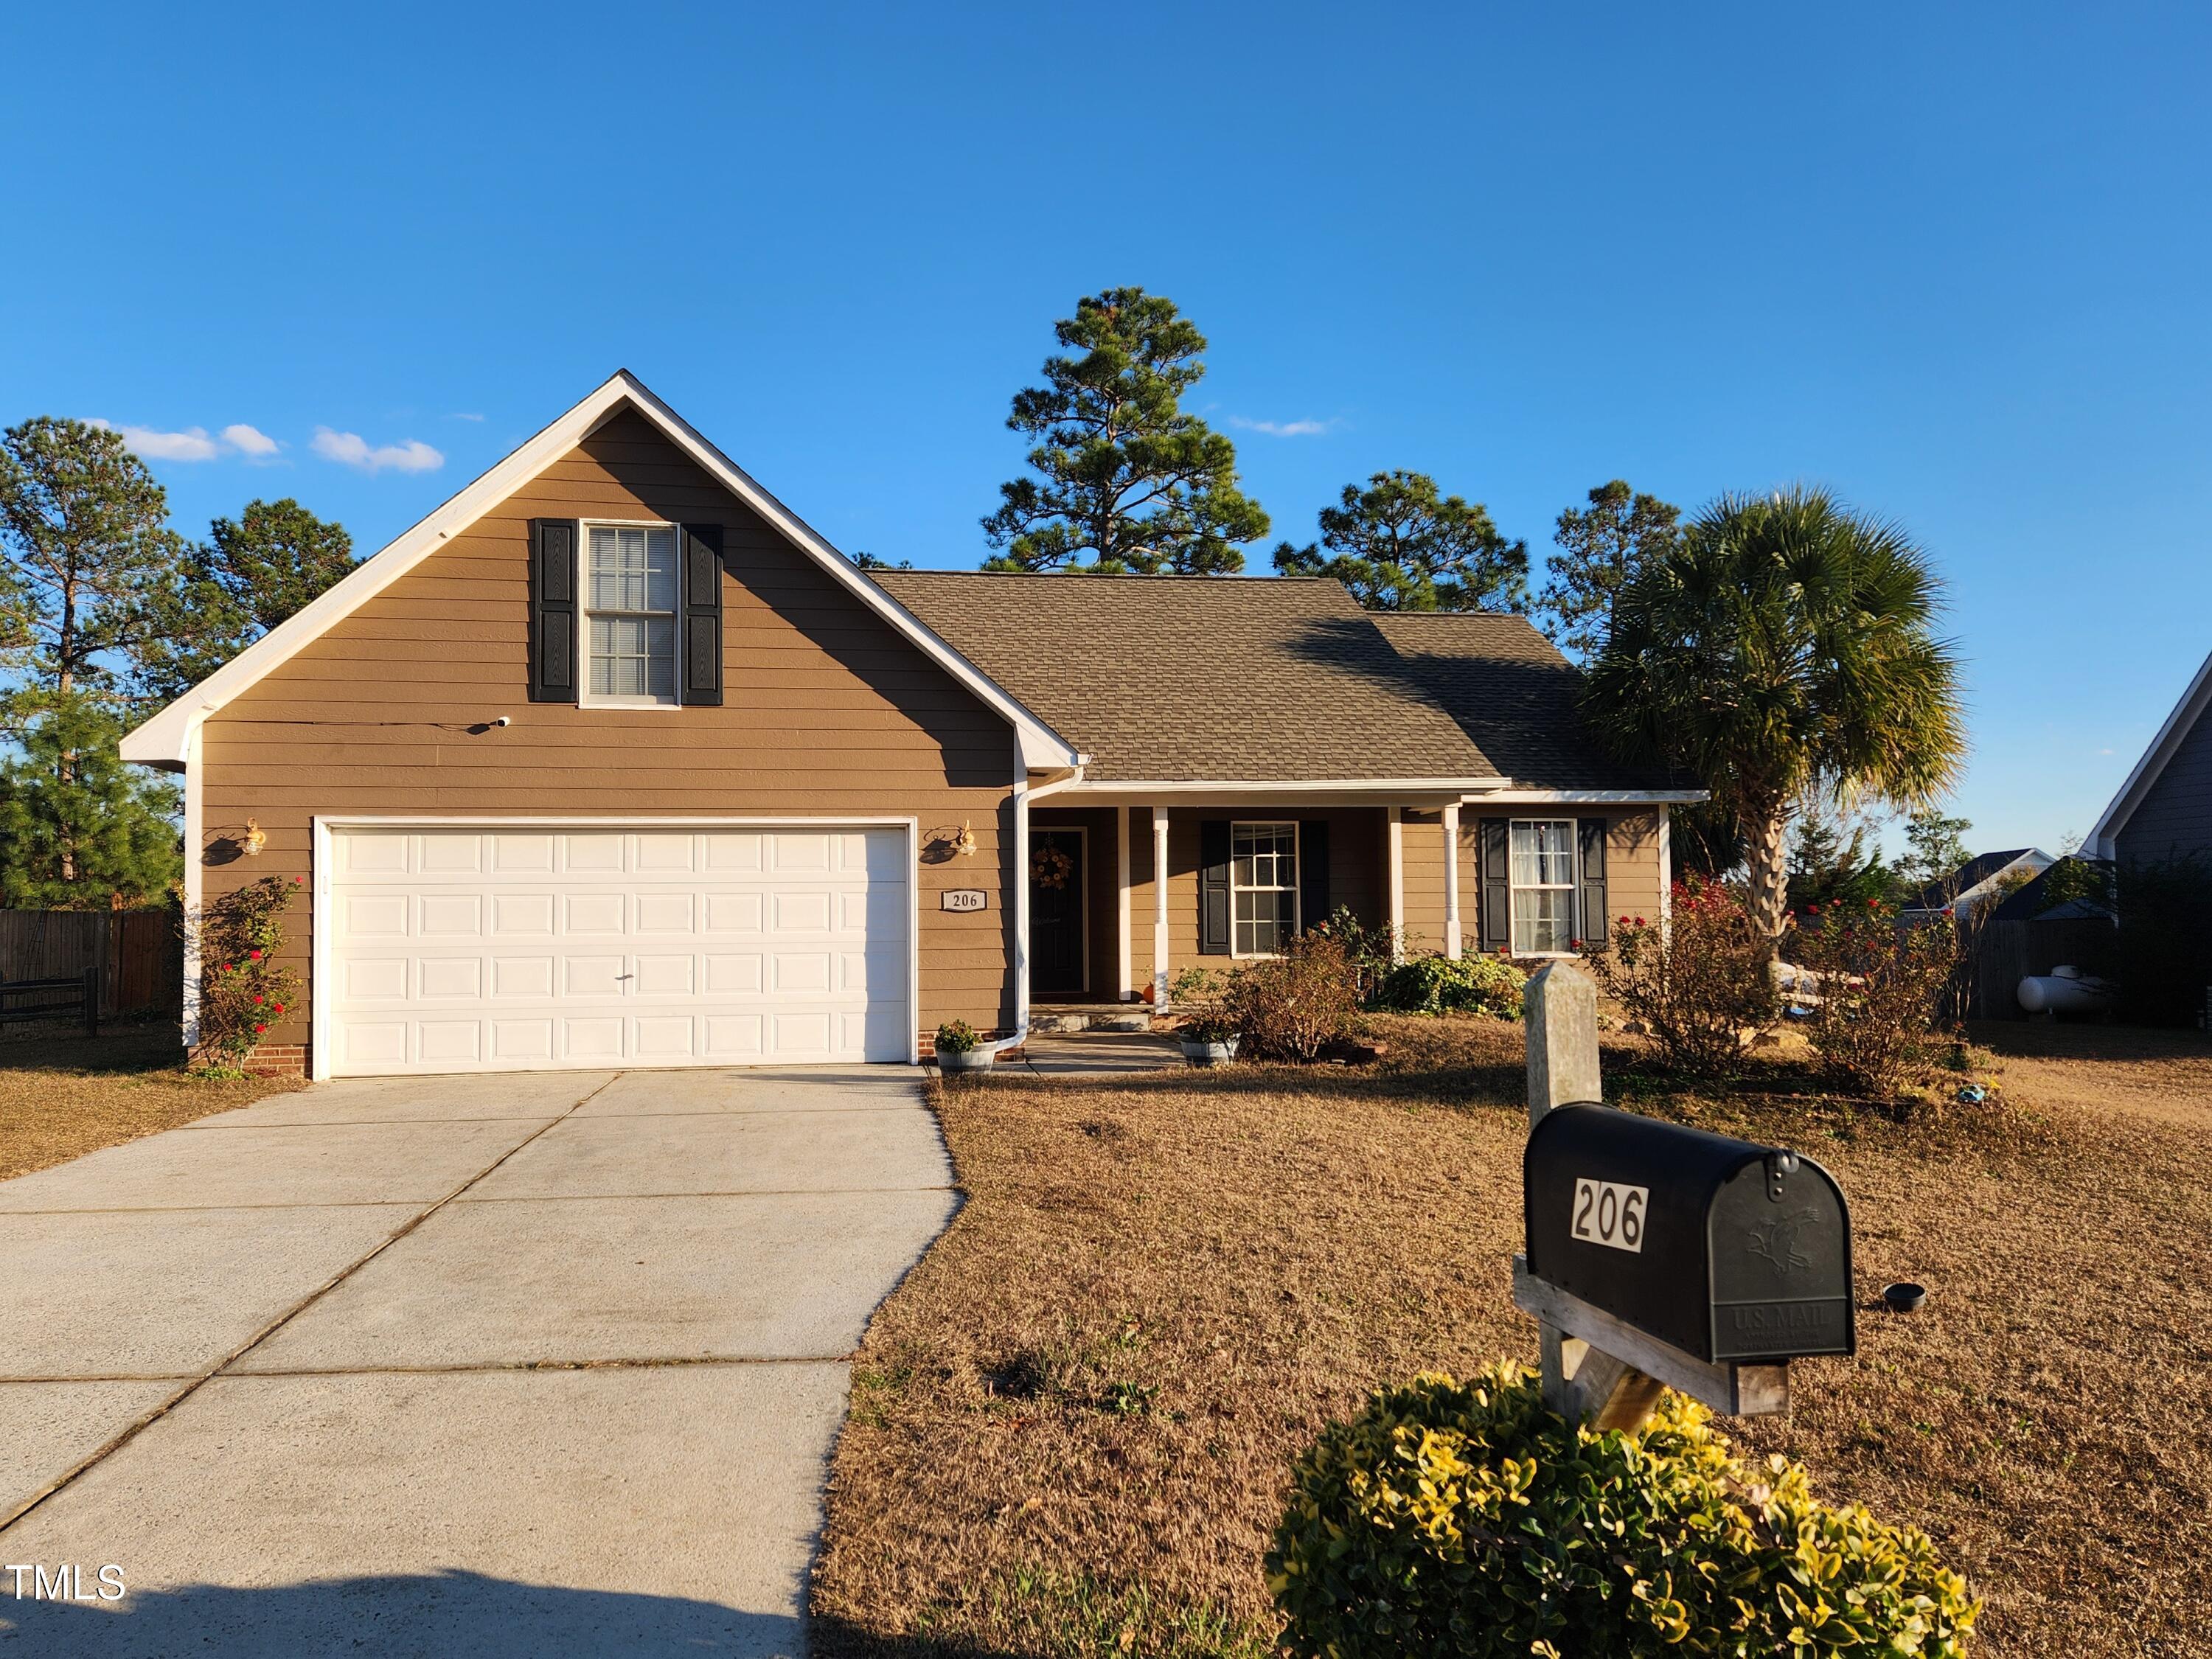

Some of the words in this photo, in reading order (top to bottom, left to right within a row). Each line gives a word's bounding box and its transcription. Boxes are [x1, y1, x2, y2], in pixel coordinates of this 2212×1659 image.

[953, 894, 977, 907] 206
[1576, 1184, 1642, 1246] 206
[1775, 1303, 1831, 1328] MAIL
